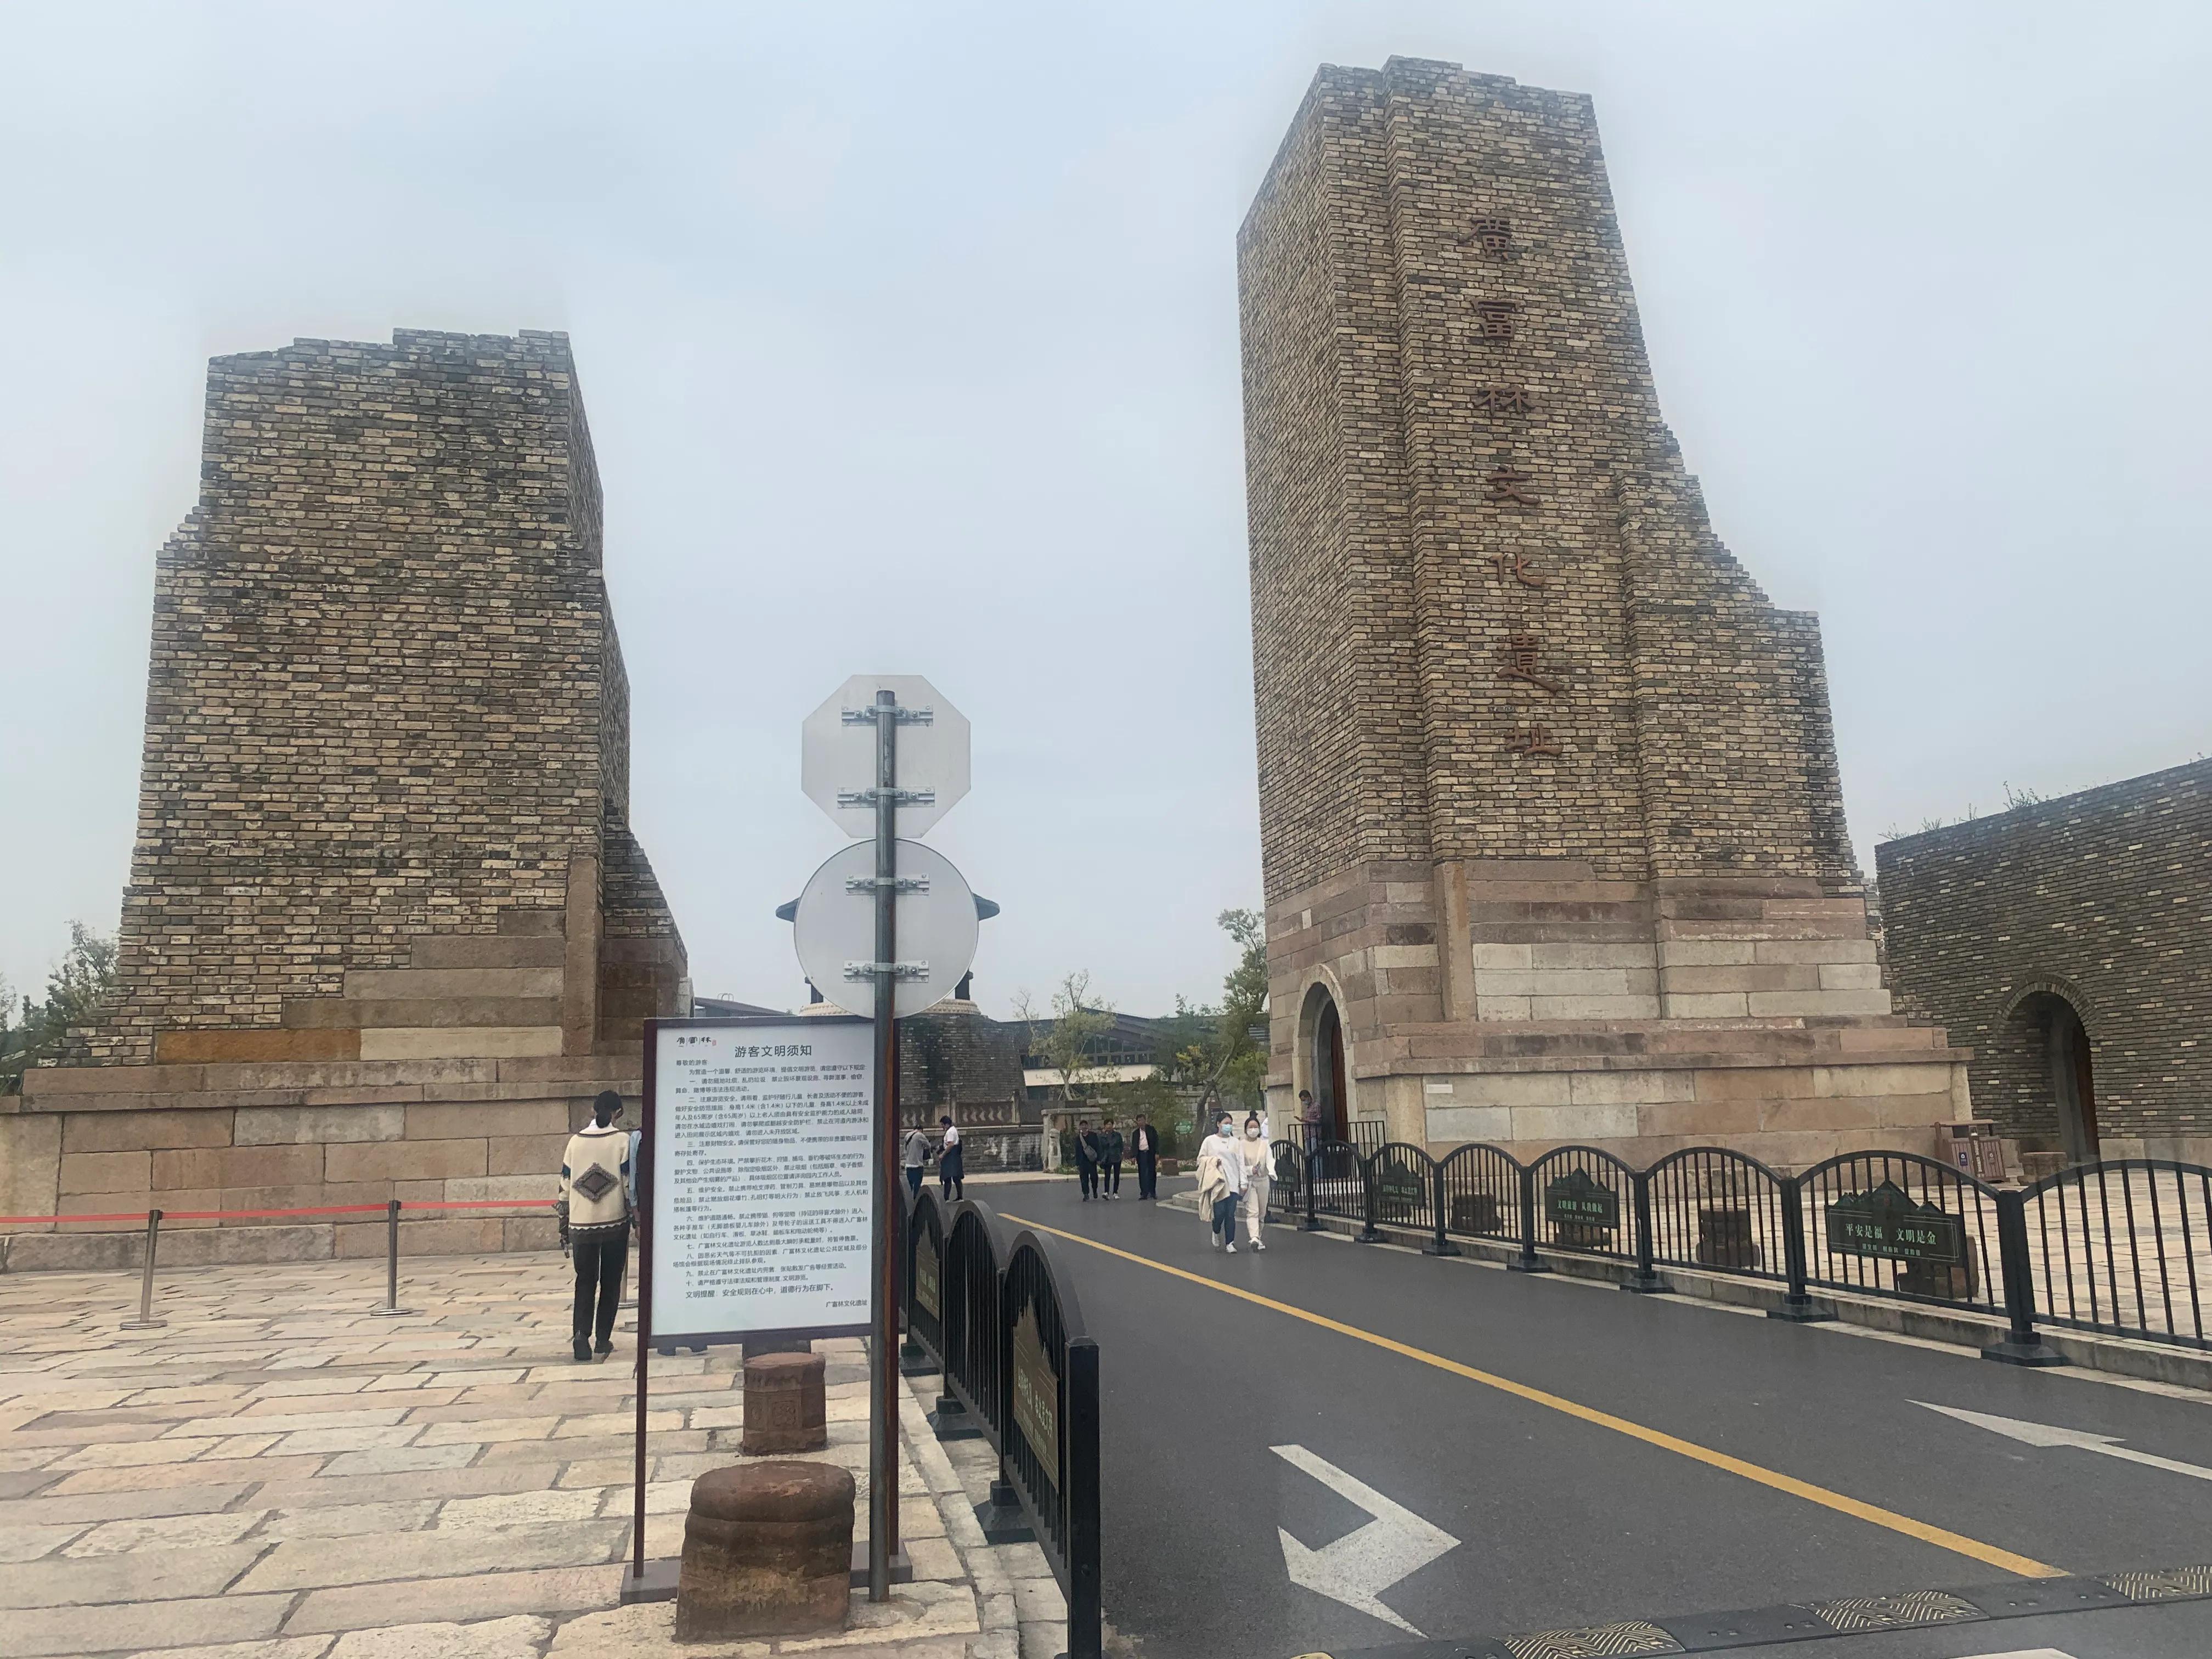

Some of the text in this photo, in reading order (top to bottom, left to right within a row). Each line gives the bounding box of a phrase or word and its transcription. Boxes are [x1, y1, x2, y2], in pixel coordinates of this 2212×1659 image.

[735, 1044, 812, 1058] 游客文明须知
[1845, 1223, 1937, 1245] 平安是福 文明是金
[826, 1299, 867, 1307] 广富林文化遗址
